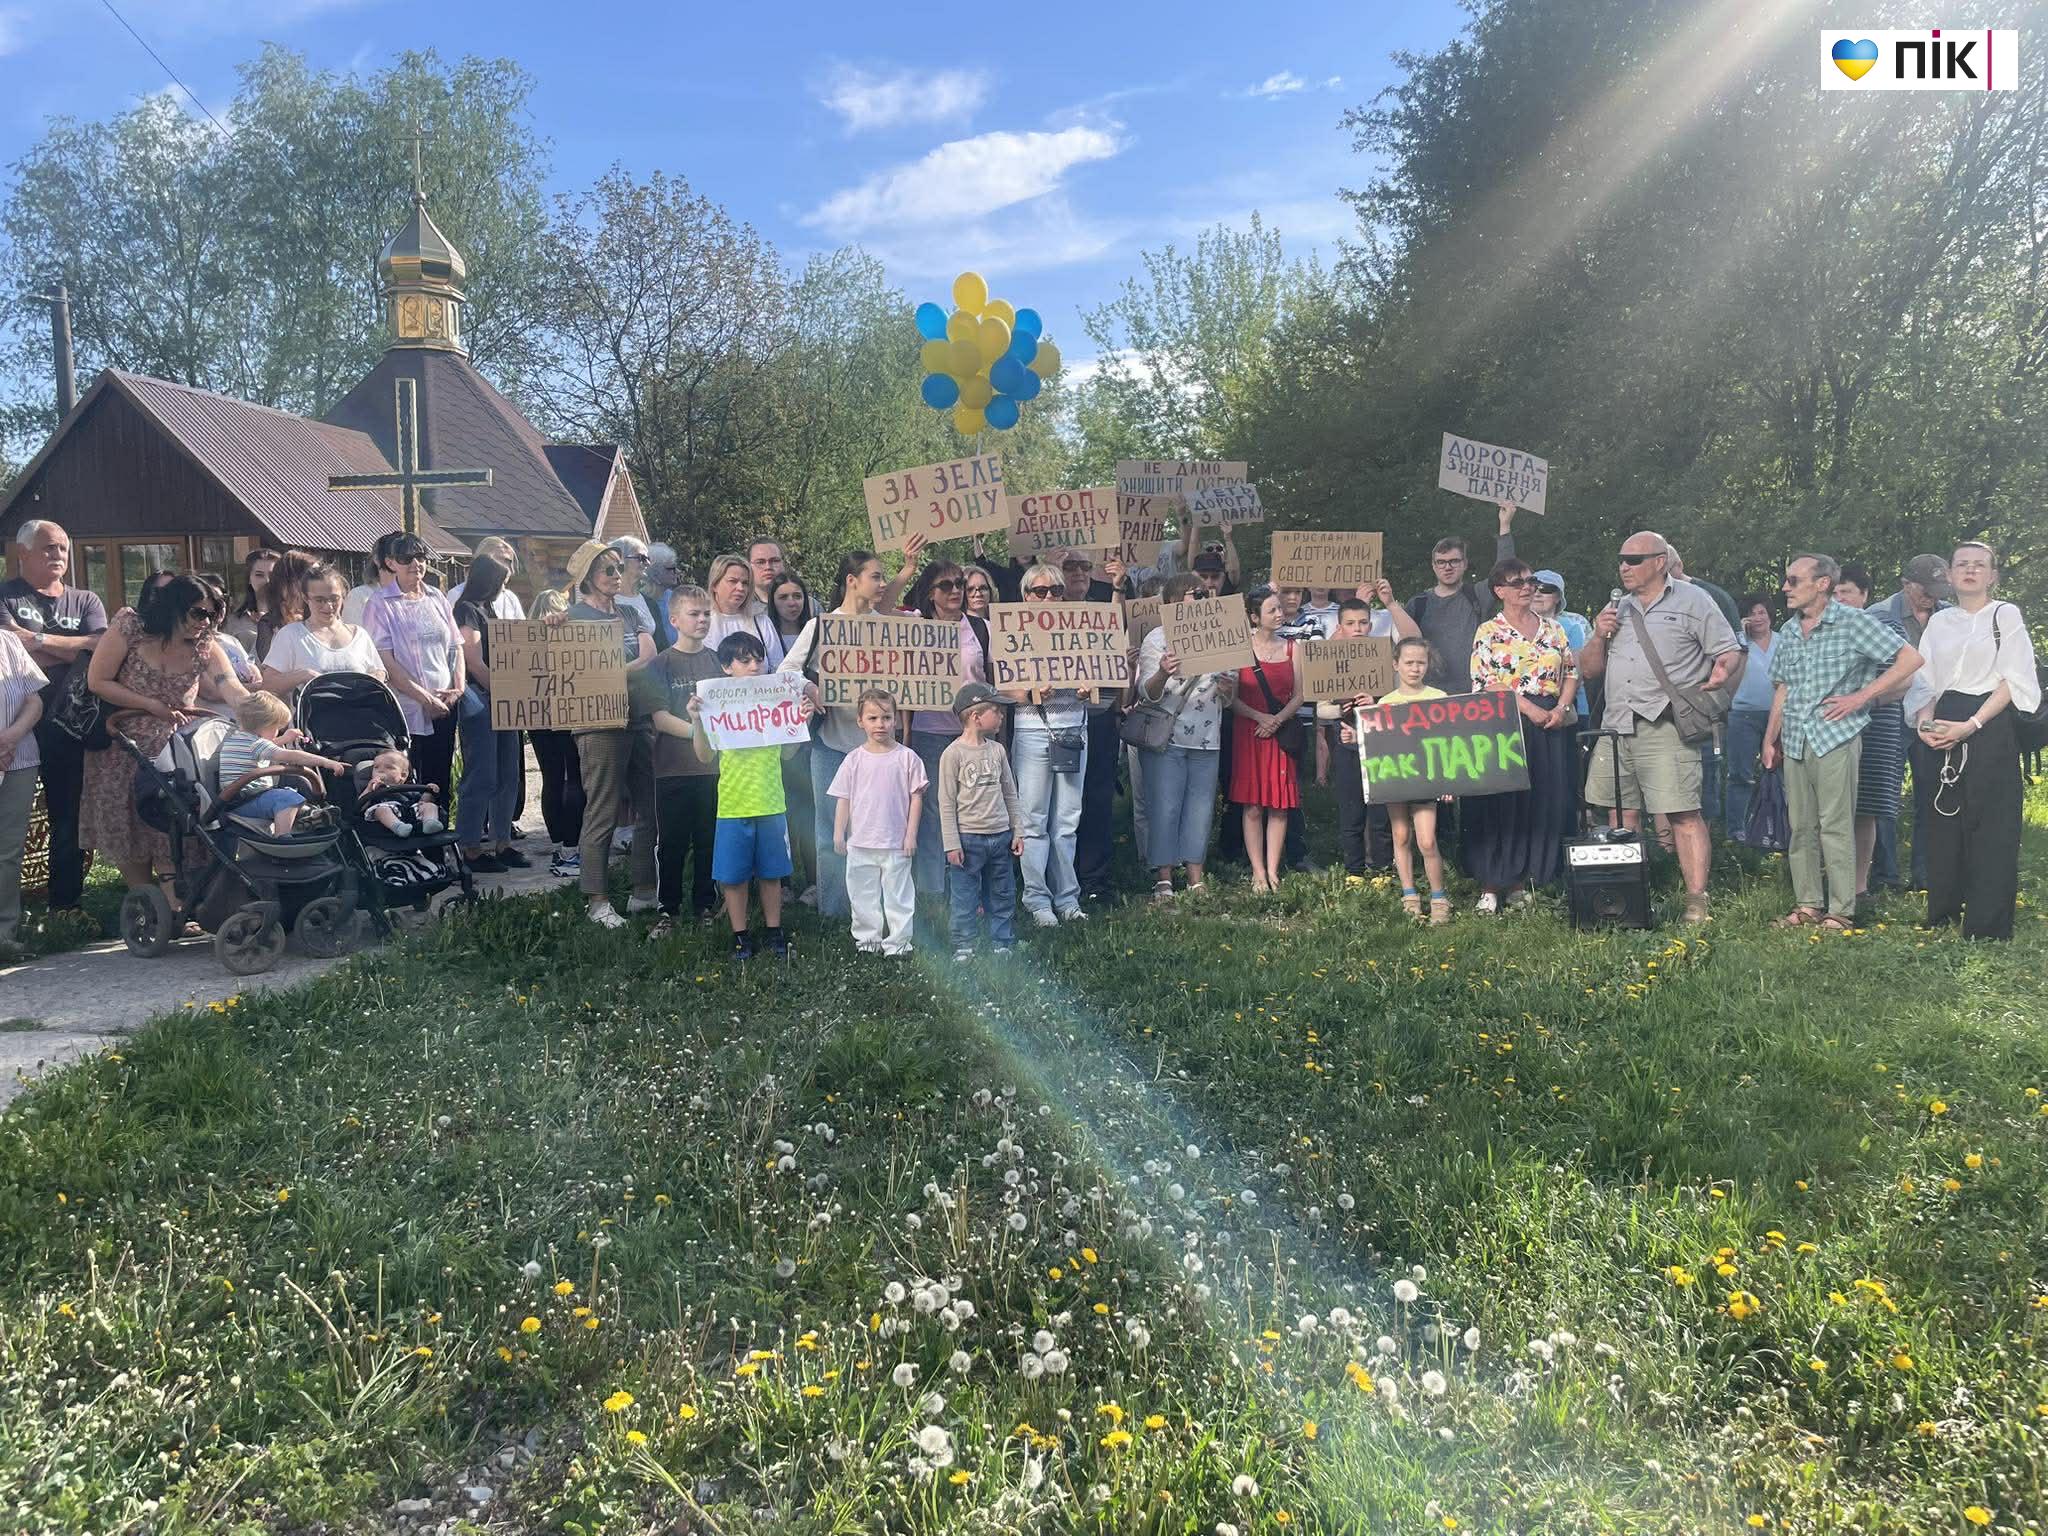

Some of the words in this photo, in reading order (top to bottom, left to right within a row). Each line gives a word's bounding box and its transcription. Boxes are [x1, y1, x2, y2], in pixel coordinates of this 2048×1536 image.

[883, 474, 918, 505] ЗА
[933, 456, 1002, 494] ЗЕЛЕ
[1144, 462, 1161, 474] НЕ
[1176, 462, 1221, 476] ДАМО
[1447, 457, 1541, 492] ЗНИЩЕННЯ
[1195, 493, 1256, 511] ДОРОГУ
[1200, 485, 1252, 499] ГЕТЬ
[1468, 478, 1530, 503] ПАРКУ
[878, 509, 911, 541] НУ
[929, 489, 998, 528] ЗОНУ
[1021, 491, 1095, 516] СТОП
[1016, 508, 1109, 535] ДЕРИБАНУ
[1119, 518, 1165, 542] РАНІВ
[1201, 511, 1212, 524] З
[1032, 527, 1097, 550] ЗЕМЛІ
[1290, 543, 1371, 561] ДОТРИМАЙ
[1325, 560, 1379, 583] СЛОВО!
[527, 624, 613, 643] БУДОВАМ
[822, 619, 959, 649] КАШТАНОВИЙ
[998, 611, 1120, 632] ГРОМАДА
[1004, 633, 1034, 653] ЗА
[1050, 632, 1116, 651] ПАРК
[1172, 619, 1250, 655] ГРОМАДУ!
[528, 648, 623, 672] ДОРОГАМ
[996, 655, 1129, 683] ВЕТЕРАНІВ
[1336, 660, 1350, 674] НЕ
[531, 672, 576, 697] ТАК
[1312, 666, 1384, 694] ШАНХАЙ!
[496, 698, 553, 727] ПАРК
[1360, 703, 1394, 734] НІ
[1401, 691, 1506, 735] ДОРОЗІ
[1362, 752, 1420, 783] ТАК
[1421, 731, 1525, 781] ПАРК
